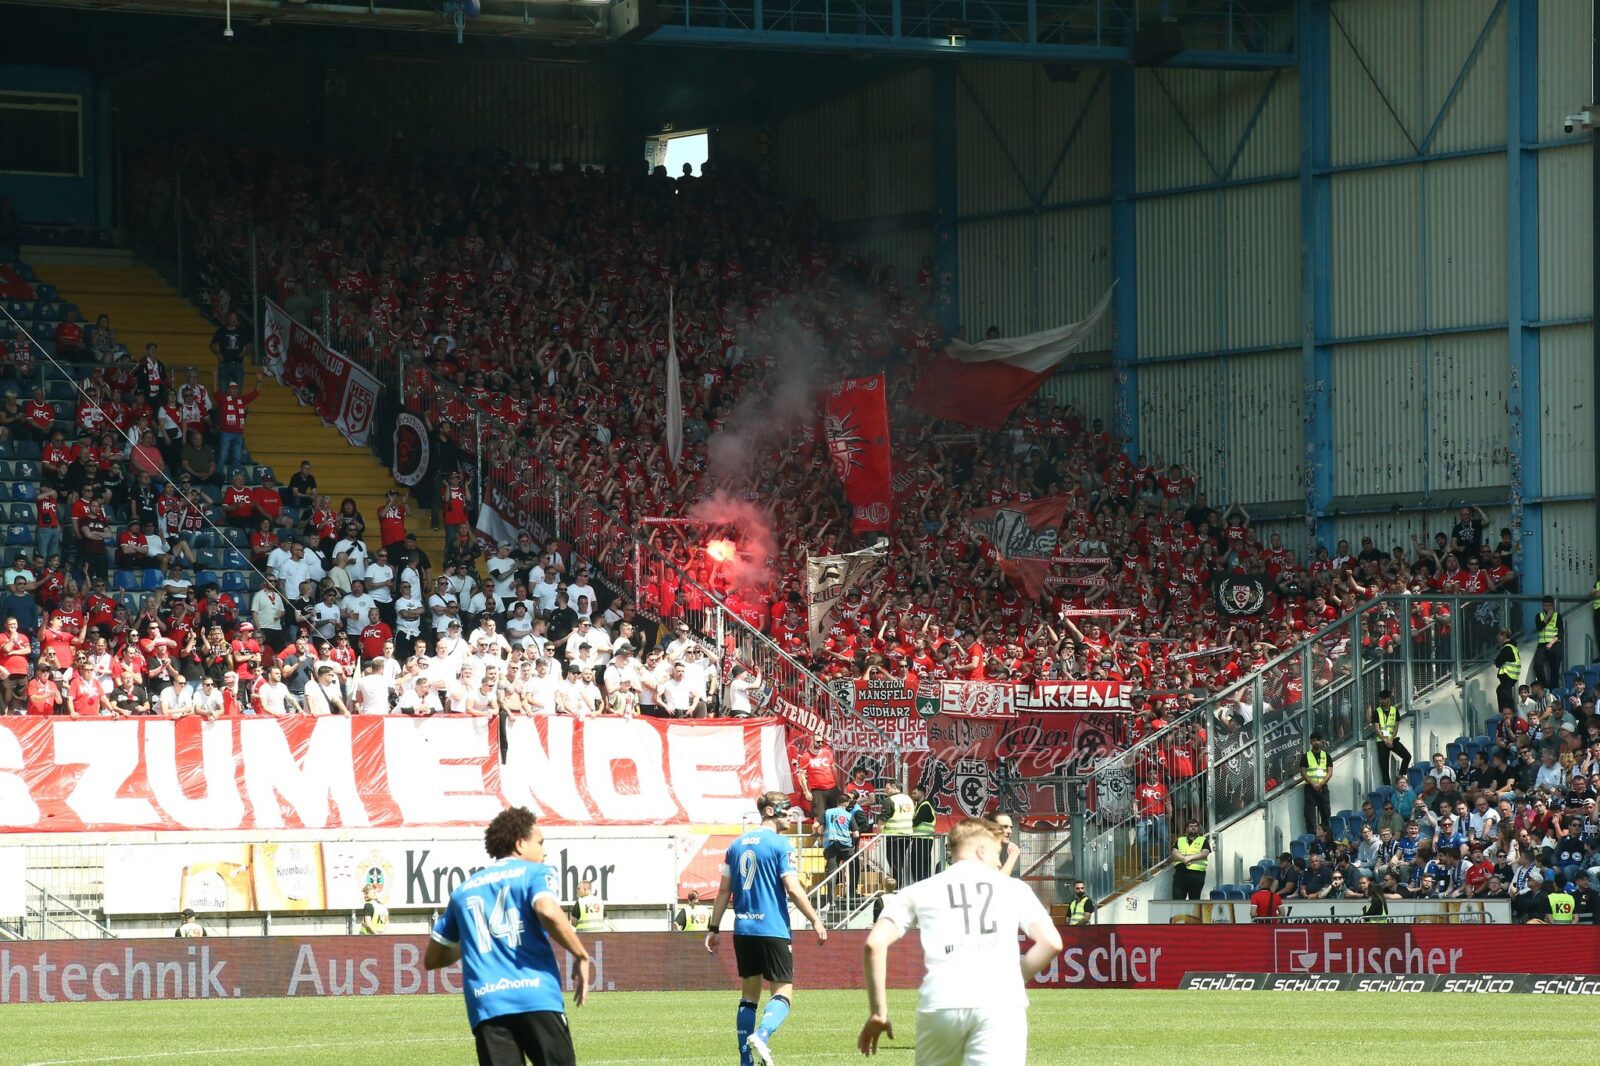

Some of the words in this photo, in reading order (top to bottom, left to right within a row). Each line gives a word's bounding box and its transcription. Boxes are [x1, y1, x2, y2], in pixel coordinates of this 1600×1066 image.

[351, 380, 372, 403] HFC
[33, 409, 49, 421] HFC
[233, 494, 250, 505] HFC
[60, 615, 79, 627] HFC
[363, 629, 381, 639] HFC
[868, 680, 905, 689] SEKTION
[858, 689, 914, 701] MANSFELD
[774, 695, 833, 742] STENDAL
[862, 704, 910, 717] SÜDHARZ
[959, 760, 985, 775] HFC
[1142, 789, 1161, 799] HFC
[405, 848, 615, 904] Kroher
[739, 849, 758, 891] 9
[585, 902, 600, 914] K9
[946, 881, 998, 935] 42
[1555, 903, 1571, 914] K9
[465, 881, 526, 954] 14
[691, 913, 706, 924] K9
[1018, 932, 1161, 984] uscher
[1323, 932, 1463, 974] Fuscher
[287, 943, 378, 996] Aus
[393, 941, 616, 994] Bield.
[1188, 973, 1256, 991] SCHÜCO
[1273, 973, 1340, 992] SCHÜCO
[1358, 974, 1425, 992] SCHÜCO
[1442, 974, 1514, 993] SCHÜCO
